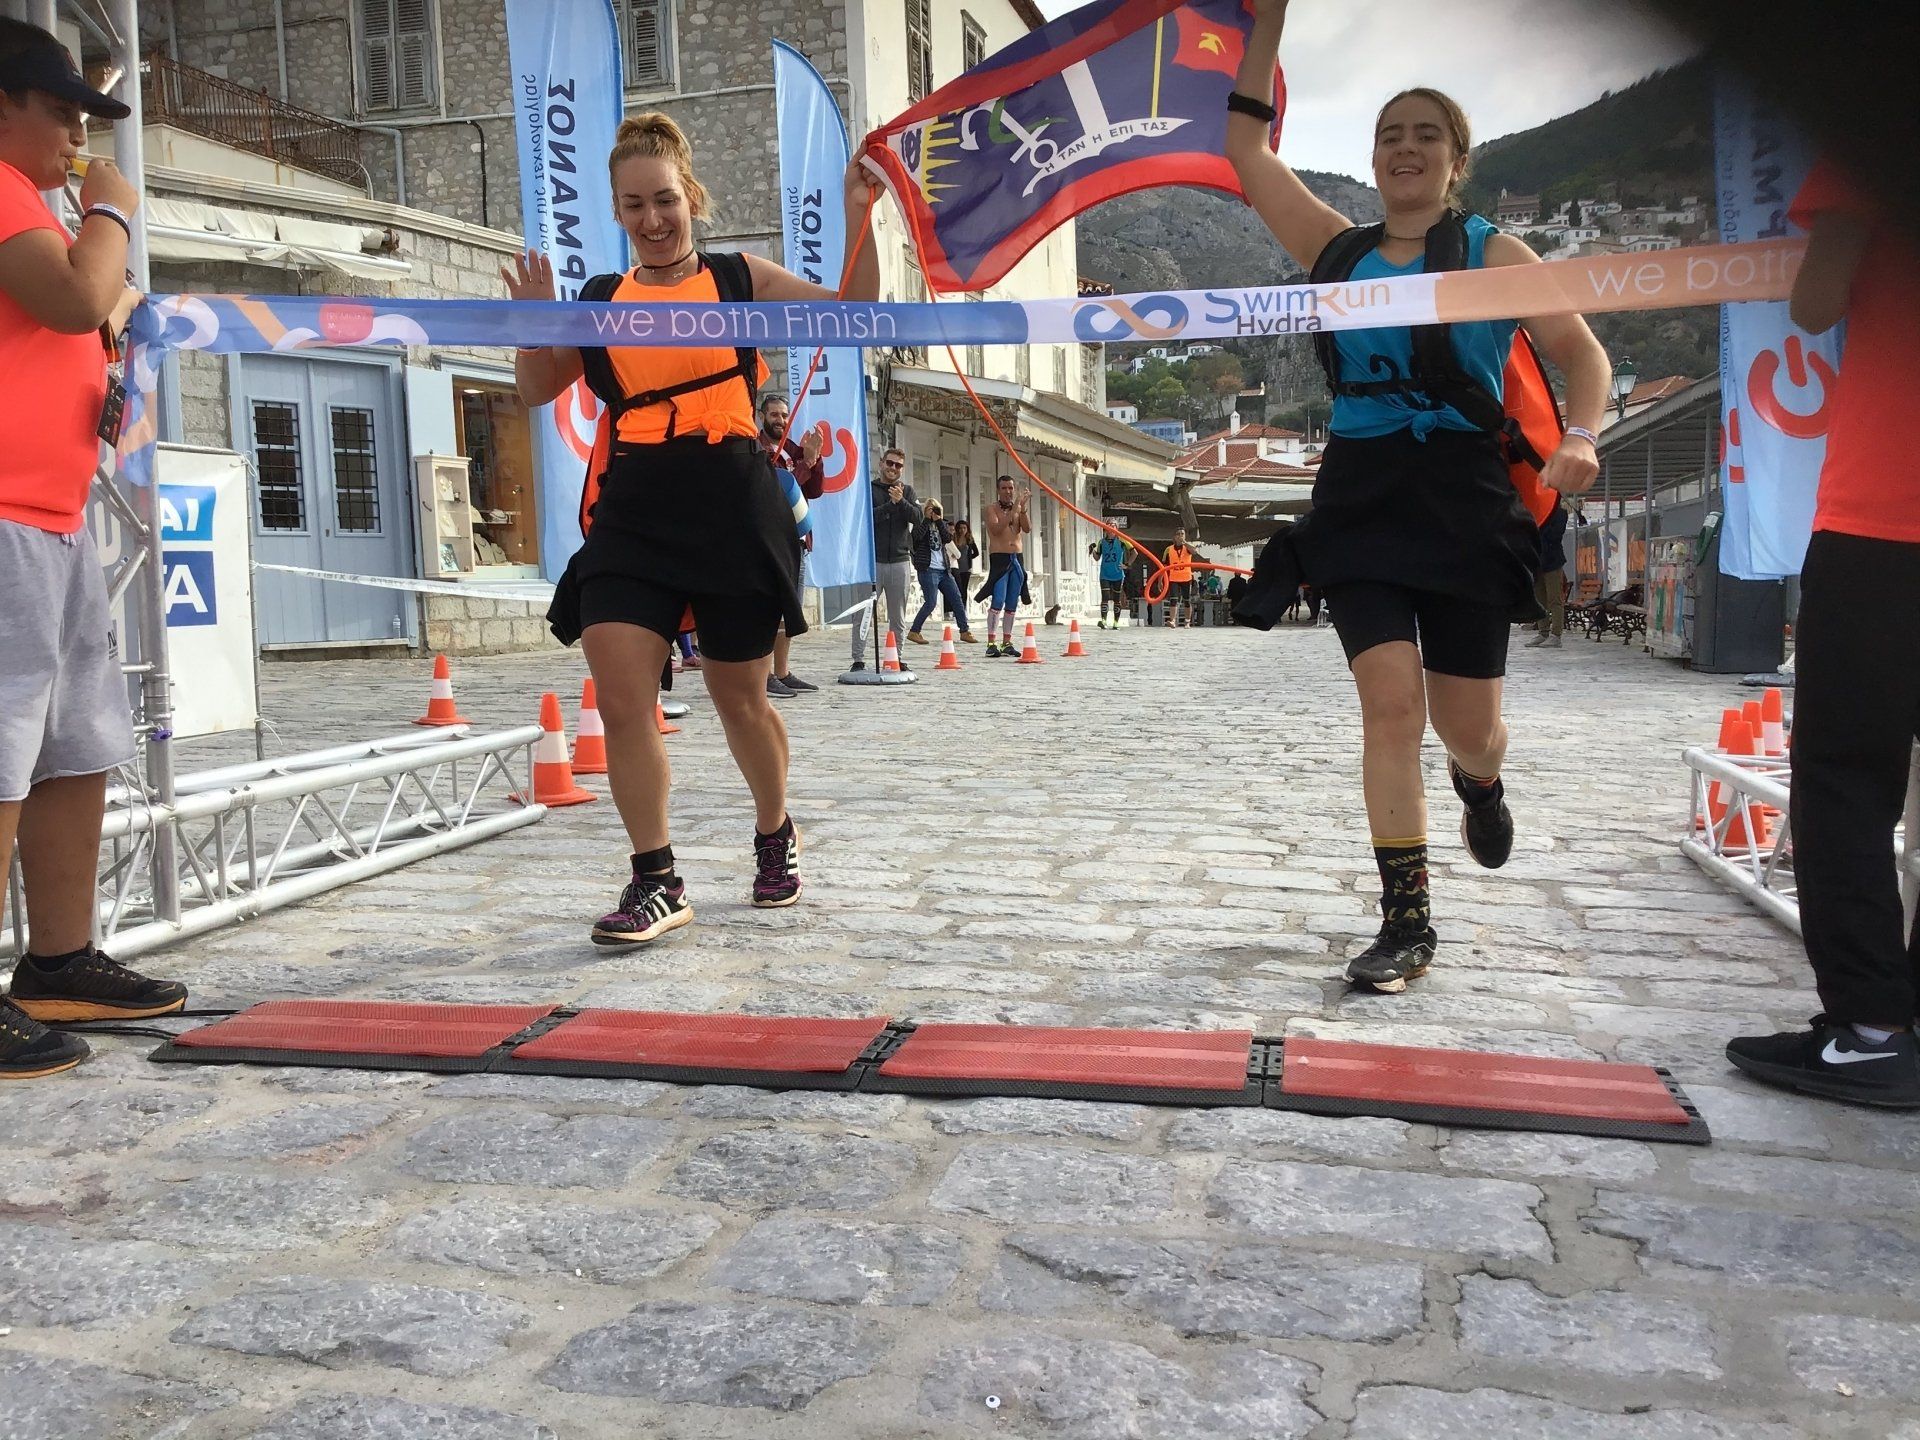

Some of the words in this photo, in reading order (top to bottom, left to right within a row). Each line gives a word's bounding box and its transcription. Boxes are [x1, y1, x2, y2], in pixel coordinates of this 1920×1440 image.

[1045, 164, 1054, 173] Η
[1059, 142, 1086, 160] ΤΑΝ
[1092, 133, 1103, 144] Η
[1109, 124, 1134, 138] ΕΠΙ
[1141, 122, 1168, 131] ΤΑΣ
[1588, 263, 1665, 298] we
[590, 309, 654, 336] we
[669, 307, 769, 339] both
[783, 304, 897, 339] Finish
[1236, 312, 1322, 335] Hydra
[1105, 553, 1117, 563] 23
